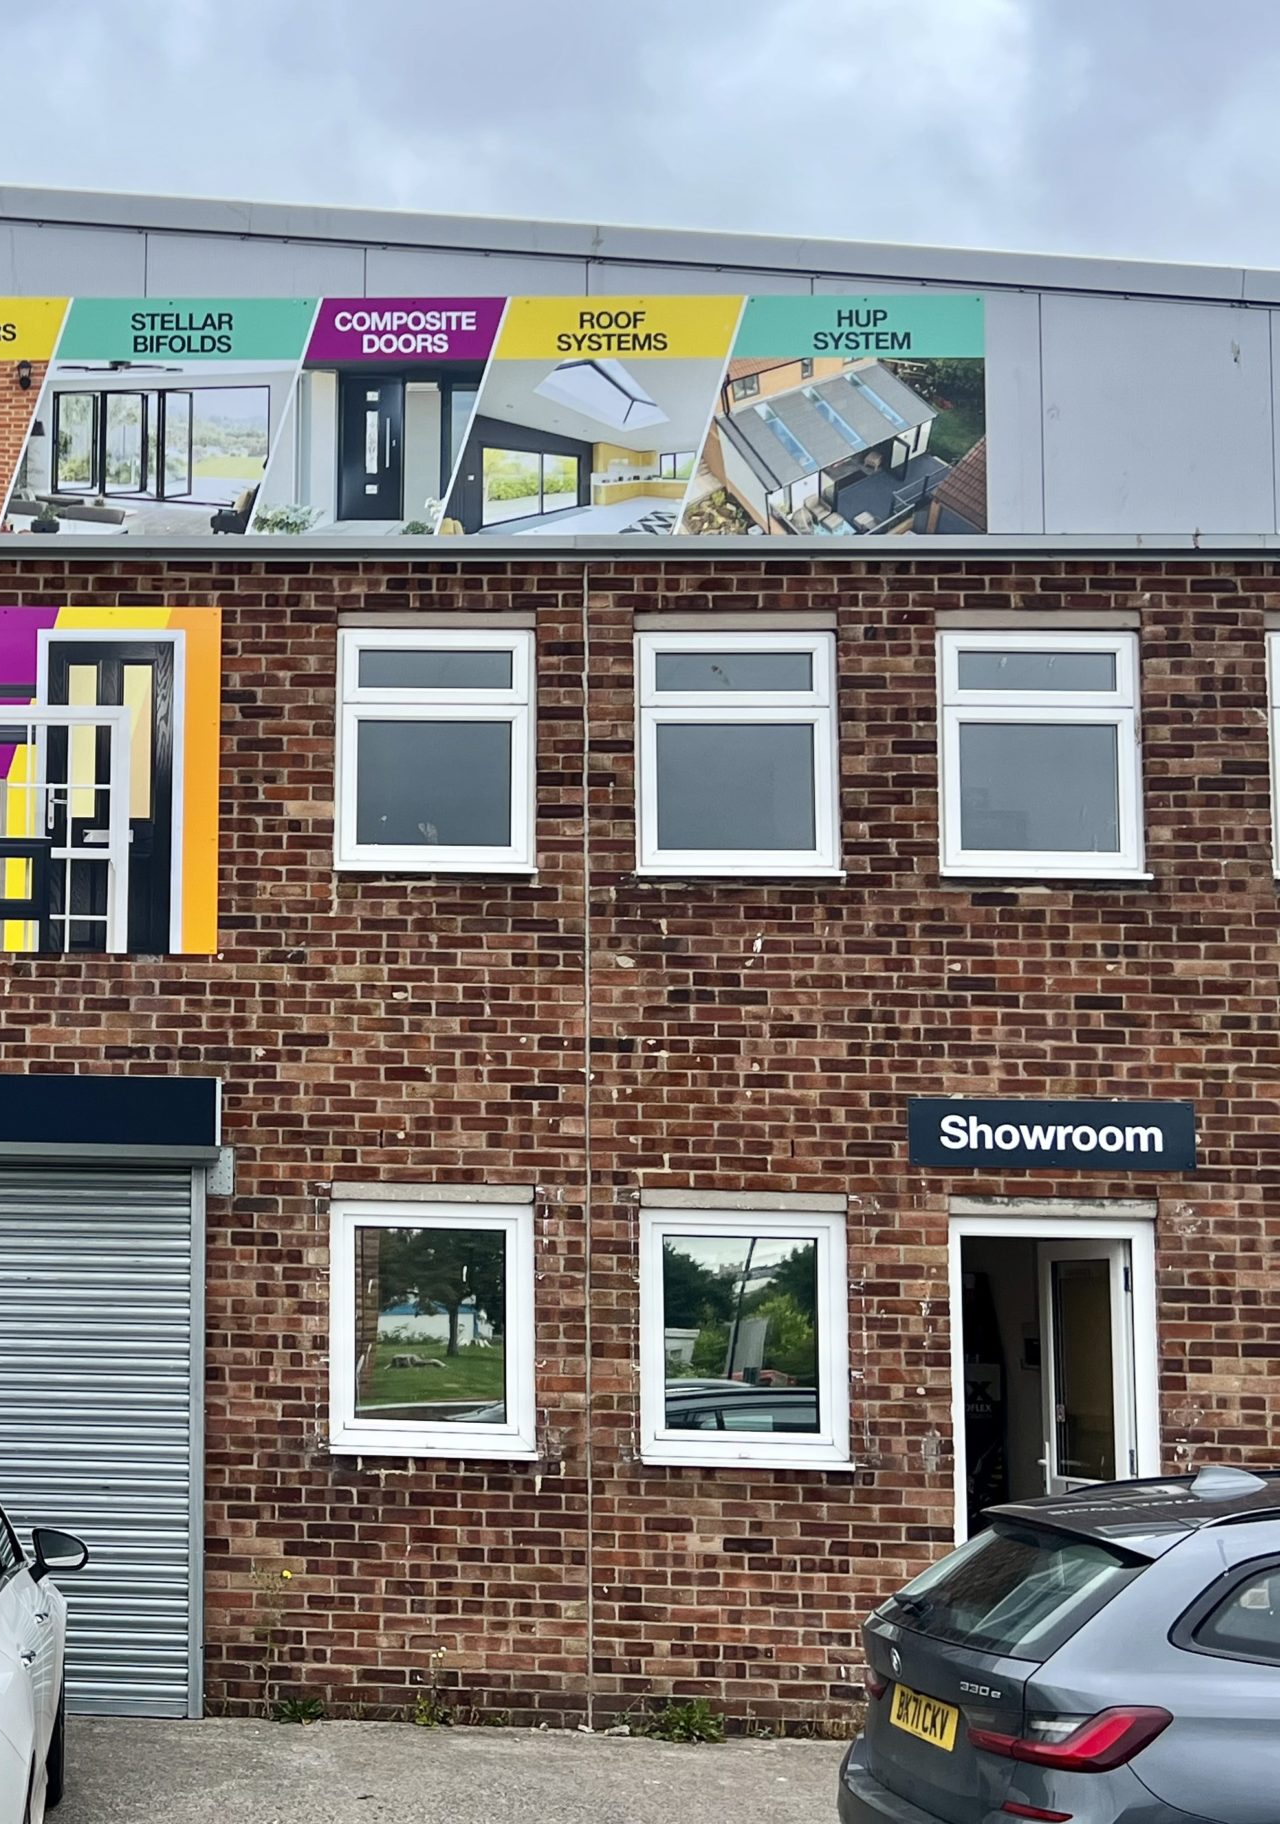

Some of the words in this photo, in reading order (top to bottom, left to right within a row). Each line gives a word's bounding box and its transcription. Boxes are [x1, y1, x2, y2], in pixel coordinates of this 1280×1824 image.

[130, 312, 233, 332] STELLAR
[334, 310, 477, 332] COMPOSITE
[578, 311, 646, 330] ROOF
[836, 309, 888, 329] HUP
[132, 334, 232, 354] BIFOLDS
[361, 332, 449, 354] DOORS
[556, 332, 668, 352] SYSTEMS
[812, 331, 911, 351] SYSTEM
[939, 1114, 1164, 1153] Showroom
